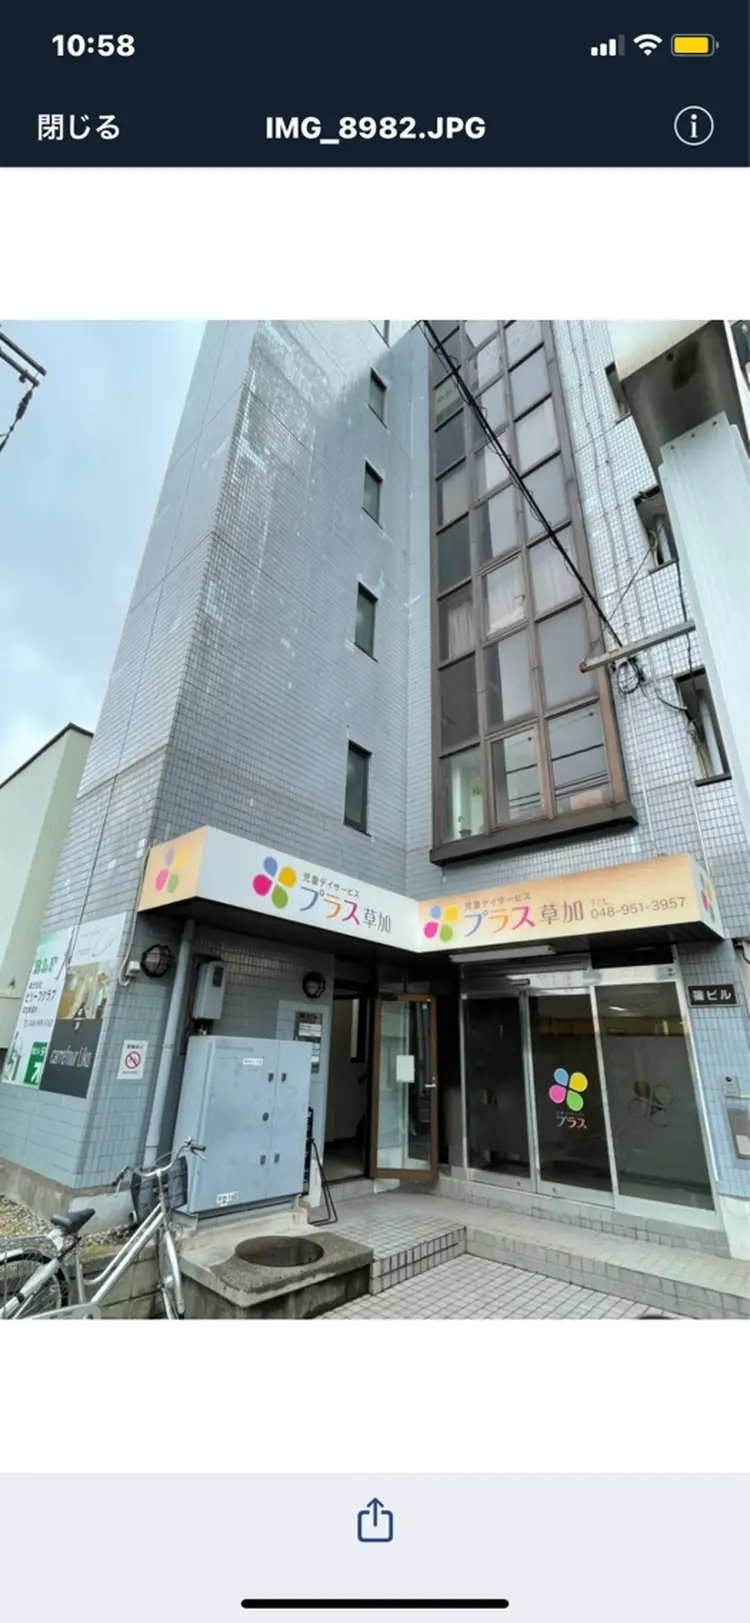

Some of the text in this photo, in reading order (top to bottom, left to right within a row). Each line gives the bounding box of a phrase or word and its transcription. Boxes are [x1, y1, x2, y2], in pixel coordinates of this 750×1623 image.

[302, 871, 361, 899] 児童デイサービス
[590, 897, 686, 920] 048-951-3957
[556, 1115, 588, 1129] プラス
